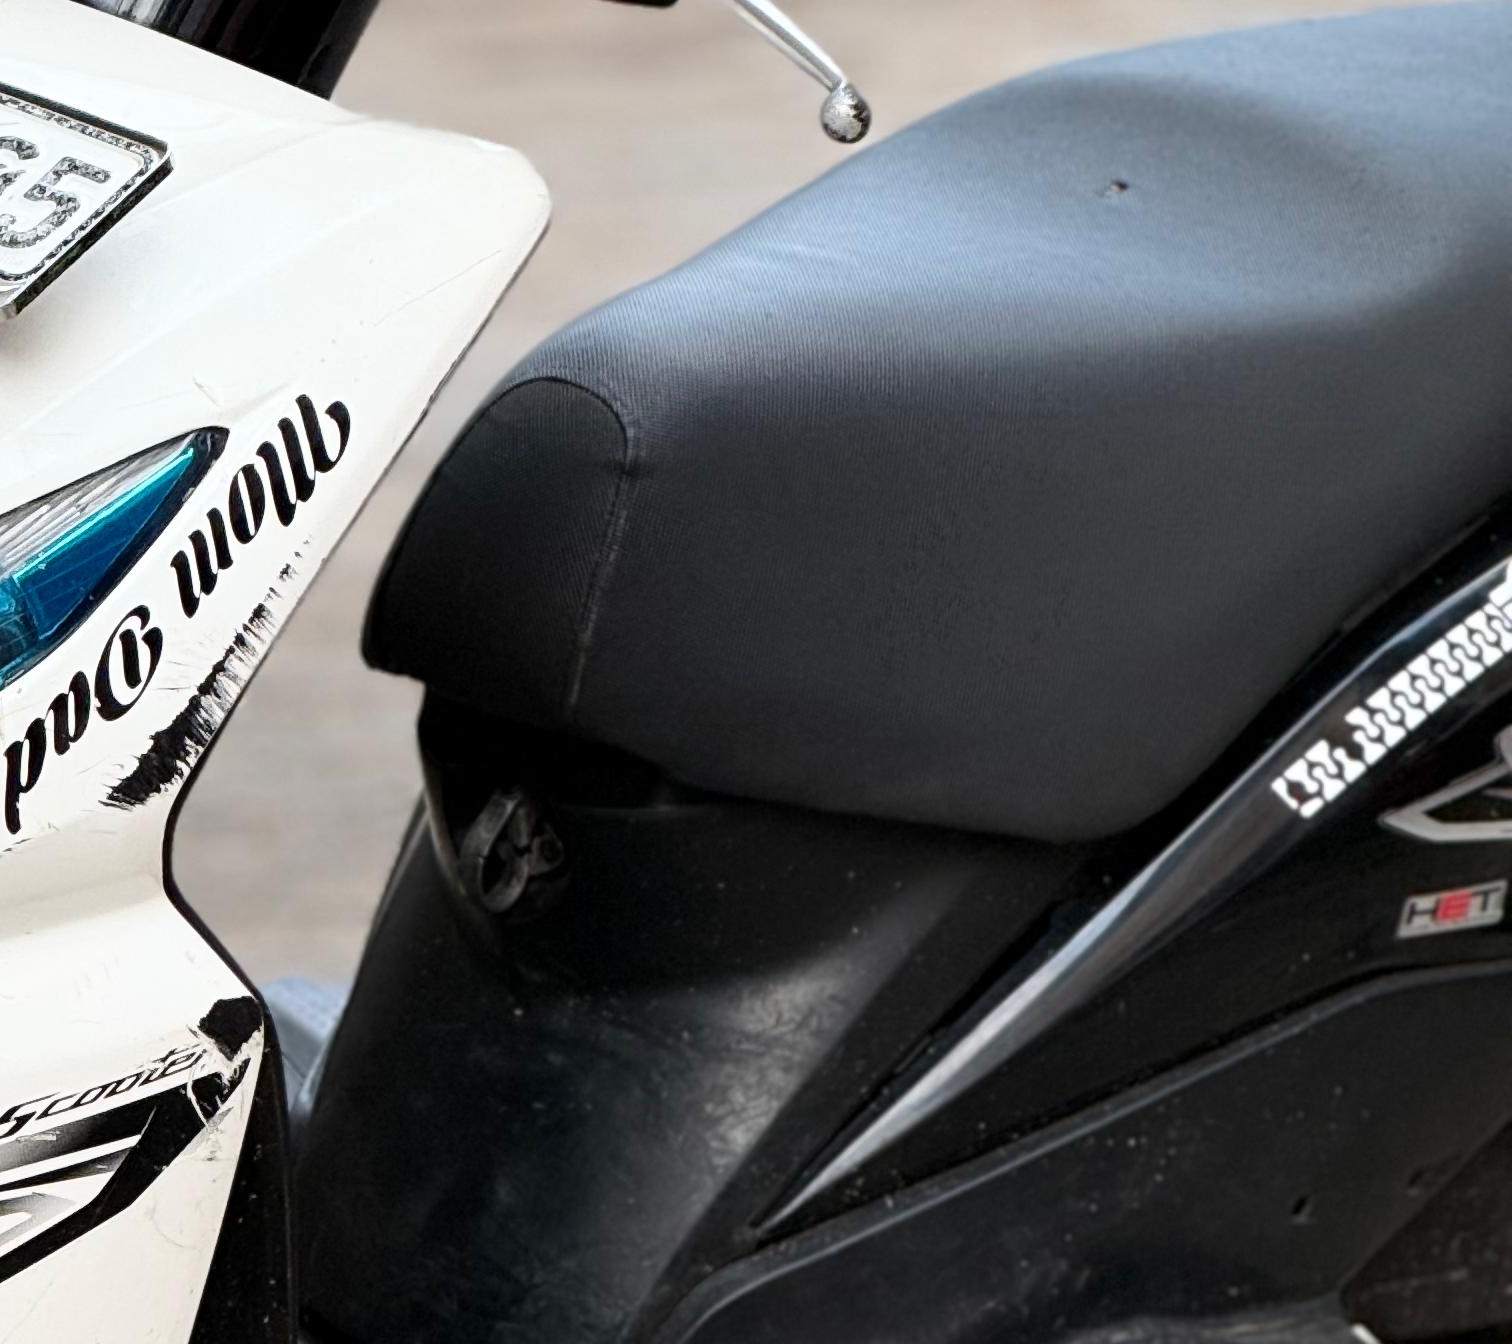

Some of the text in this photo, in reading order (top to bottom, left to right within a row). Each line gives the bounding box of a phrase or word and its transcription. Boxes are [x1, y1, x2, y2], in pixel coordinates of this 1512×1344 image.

[3, 394, 351, 835] Mom Dad
[1406, 886, 1502, 927] HET
